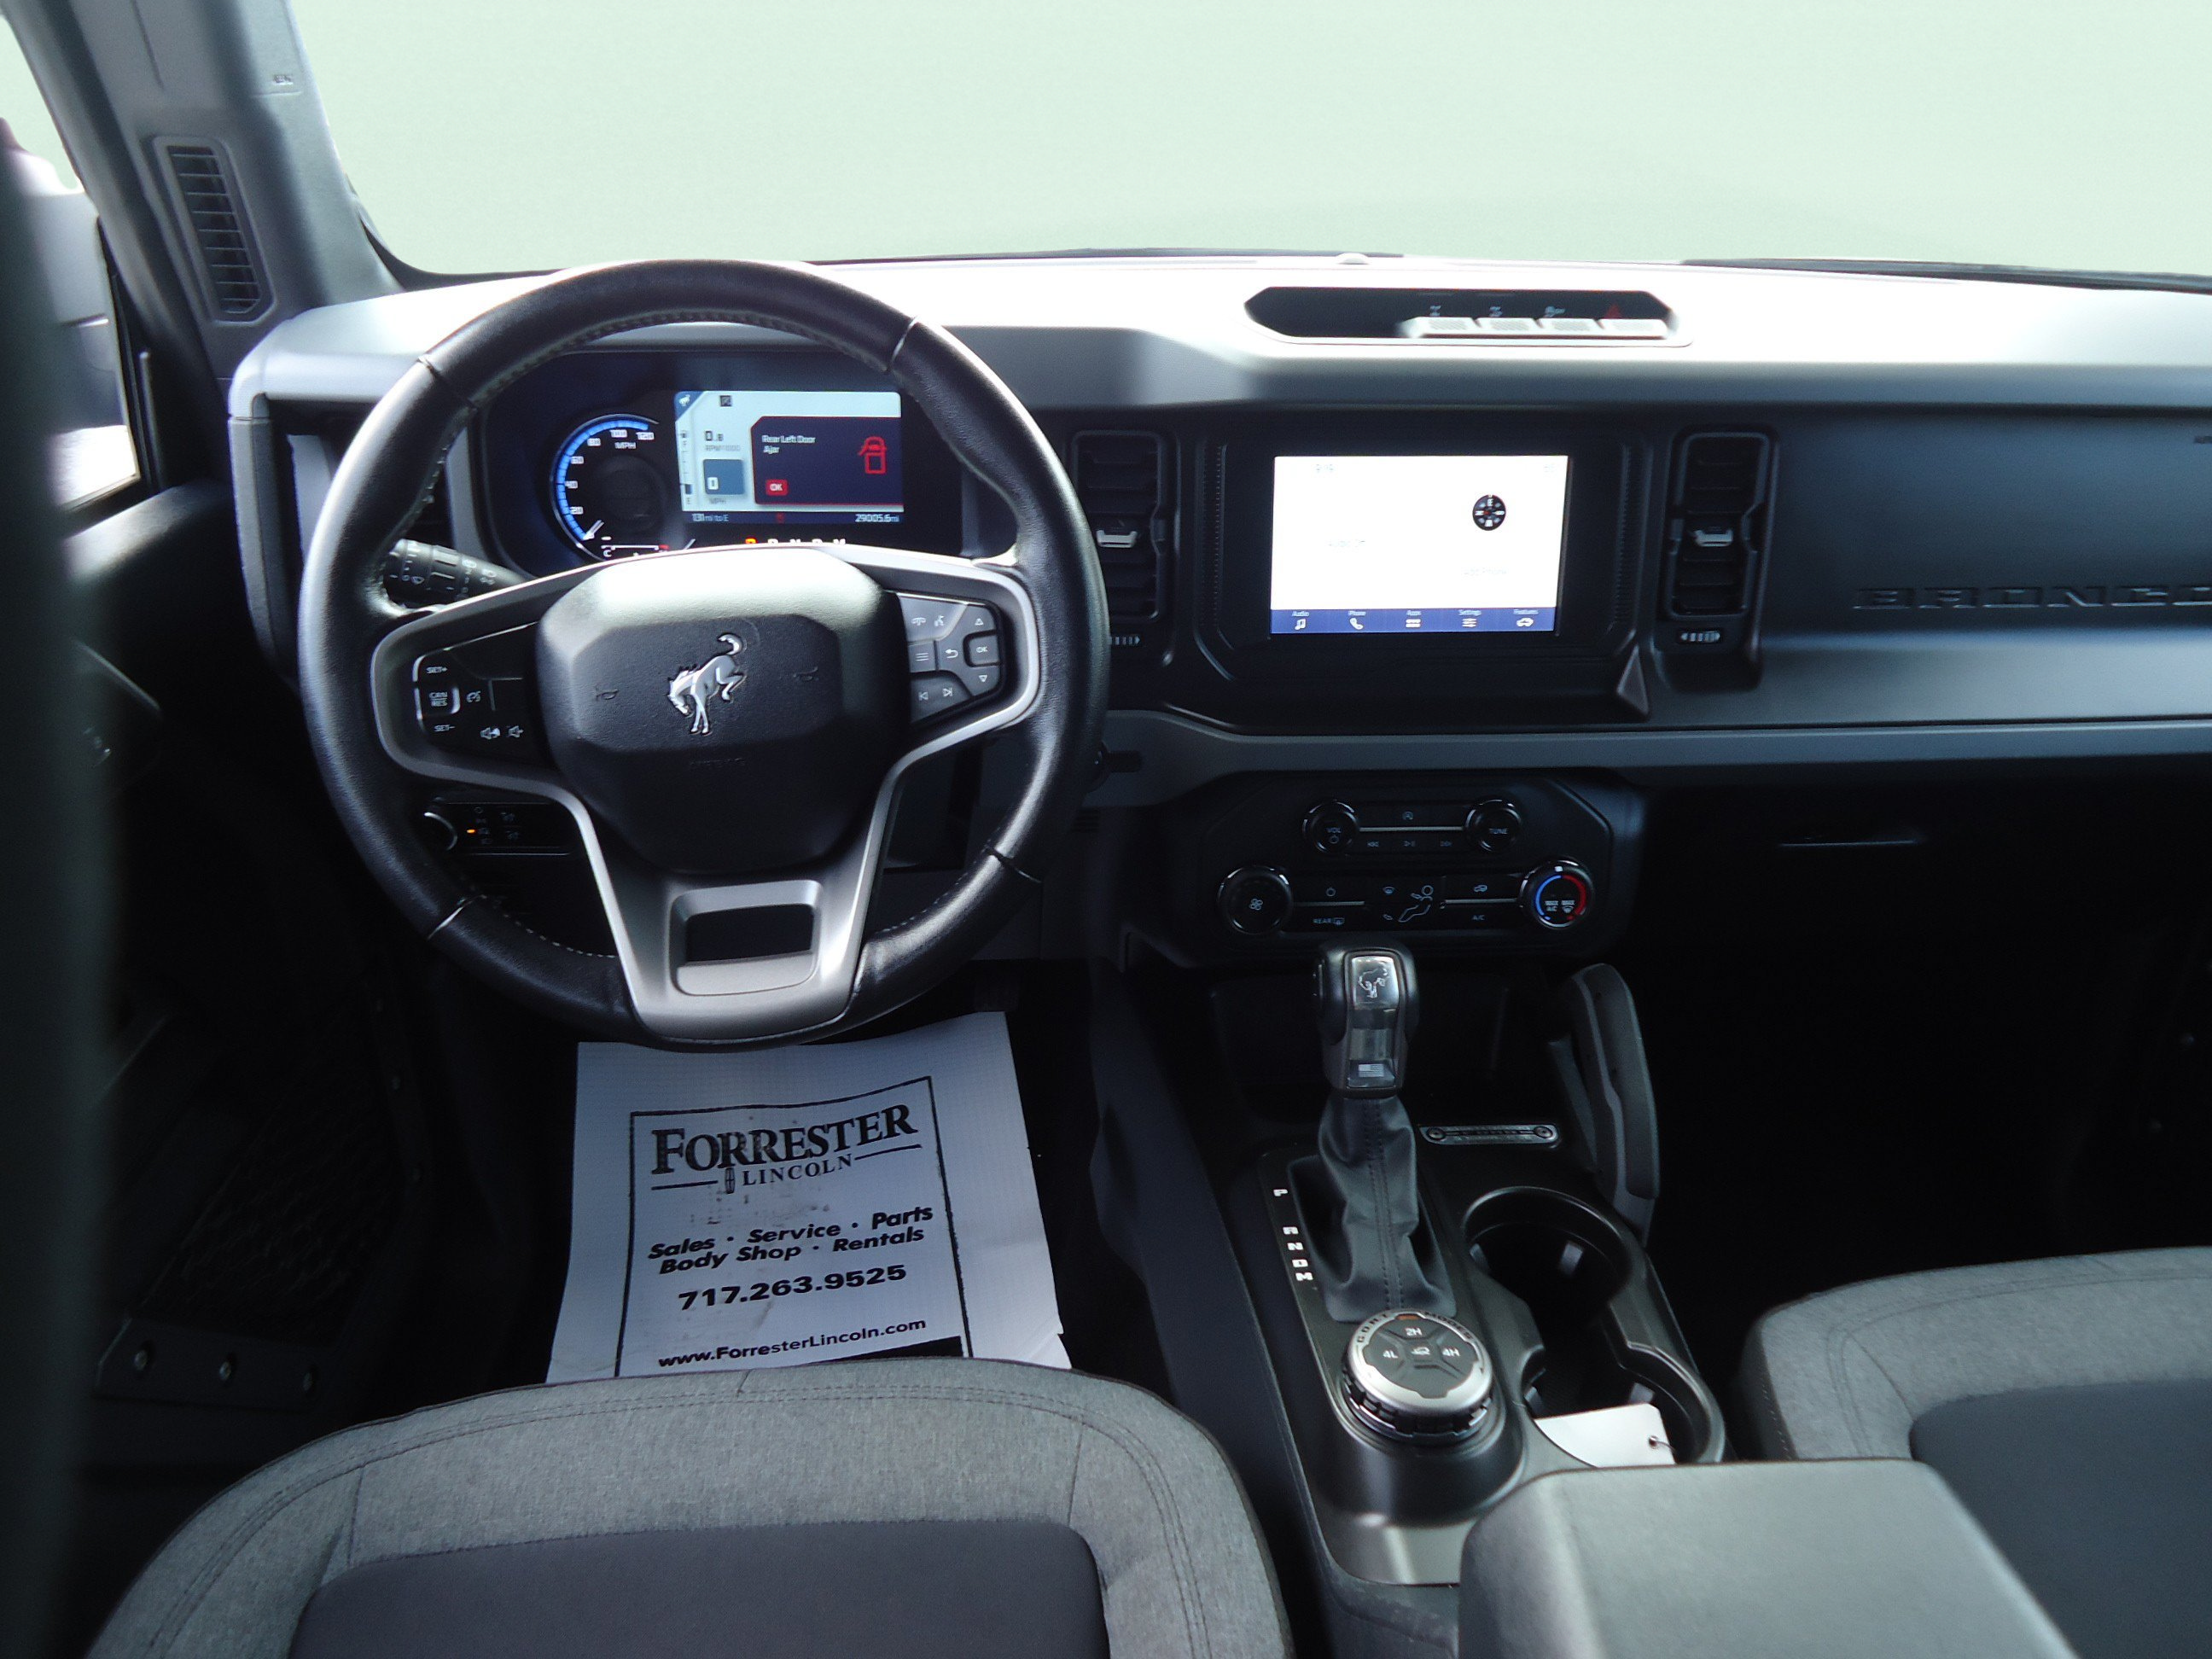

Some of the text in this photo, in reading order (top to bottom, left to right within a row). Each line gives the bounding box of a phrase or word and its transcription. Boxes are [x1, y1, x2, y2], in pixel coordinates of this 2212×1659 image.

[769, 483, 783, 492] OK
[651, 1103, 918, 1174] FORRESTER
[742, 1153, 853, 1186] LINCOLN
[648, 1206, 934, 1260] Sales Service Parts
[659, 1226, 925, 1275] Body Shop Rentals
[678, 1264, 907, 1311] 717.263.9525
[658, 1318, 927, 1367] www.ForresterLincoln.com
